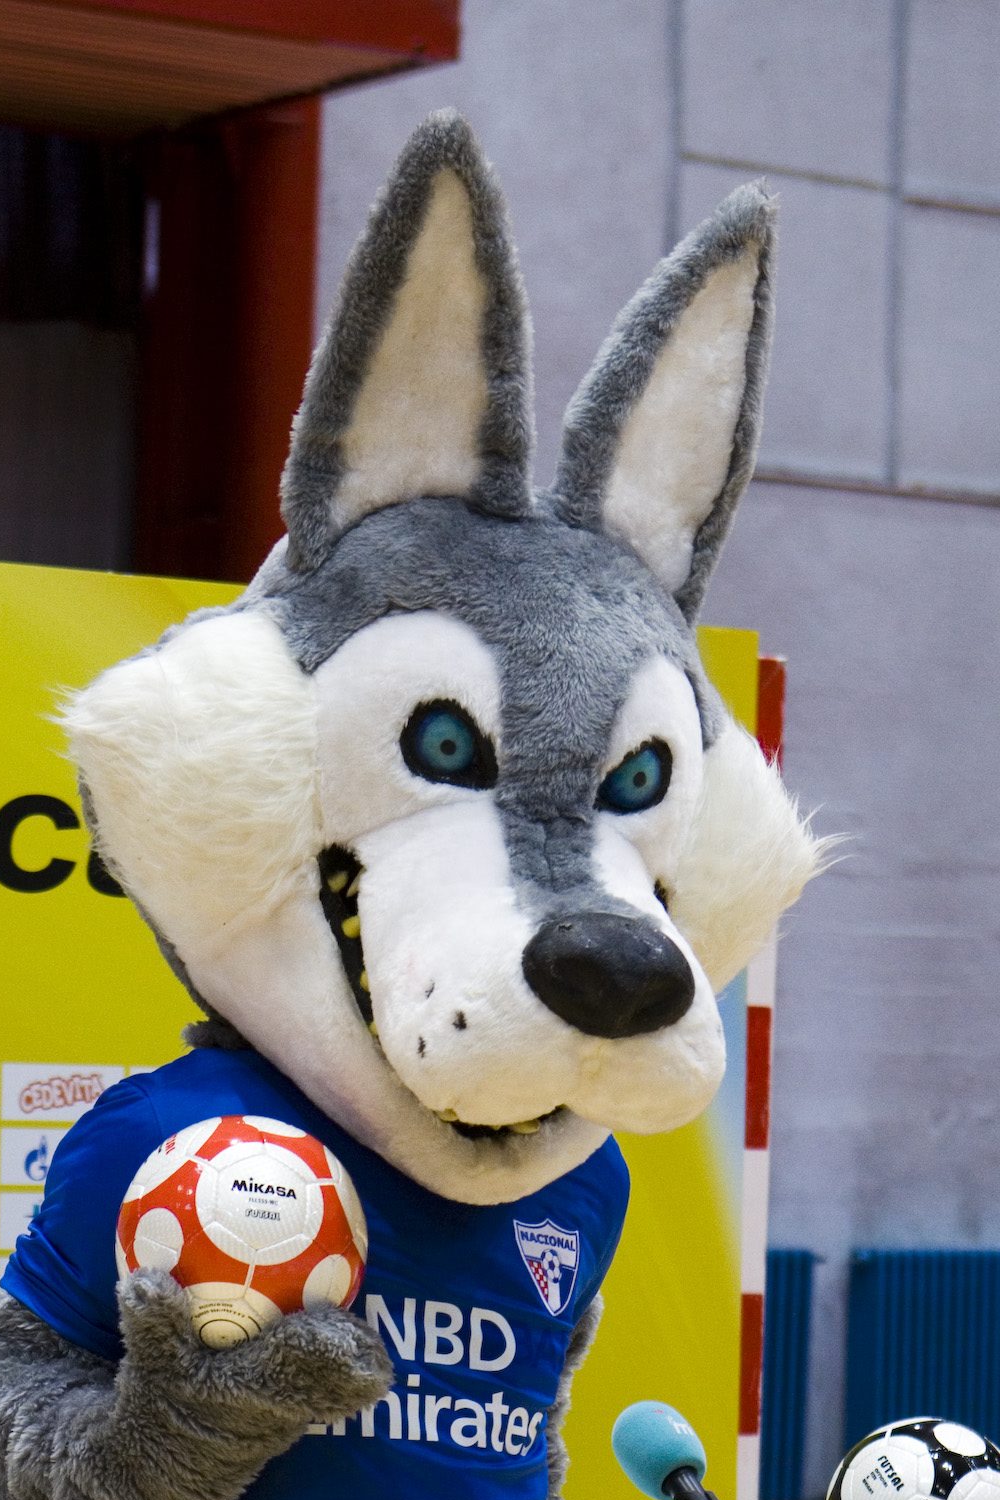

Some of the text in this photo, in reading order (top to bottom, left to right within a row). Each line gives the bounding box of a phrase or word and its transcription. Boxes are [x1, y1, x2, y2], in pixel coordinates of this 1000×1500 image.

[245, 1208, 281, 1221] FUTSAL
[520, 1230, 576, 1252] NACIONAL
[365, 1294, 516, 1372] NBD
[877, 1455, 904, 1492] FUTSAL
